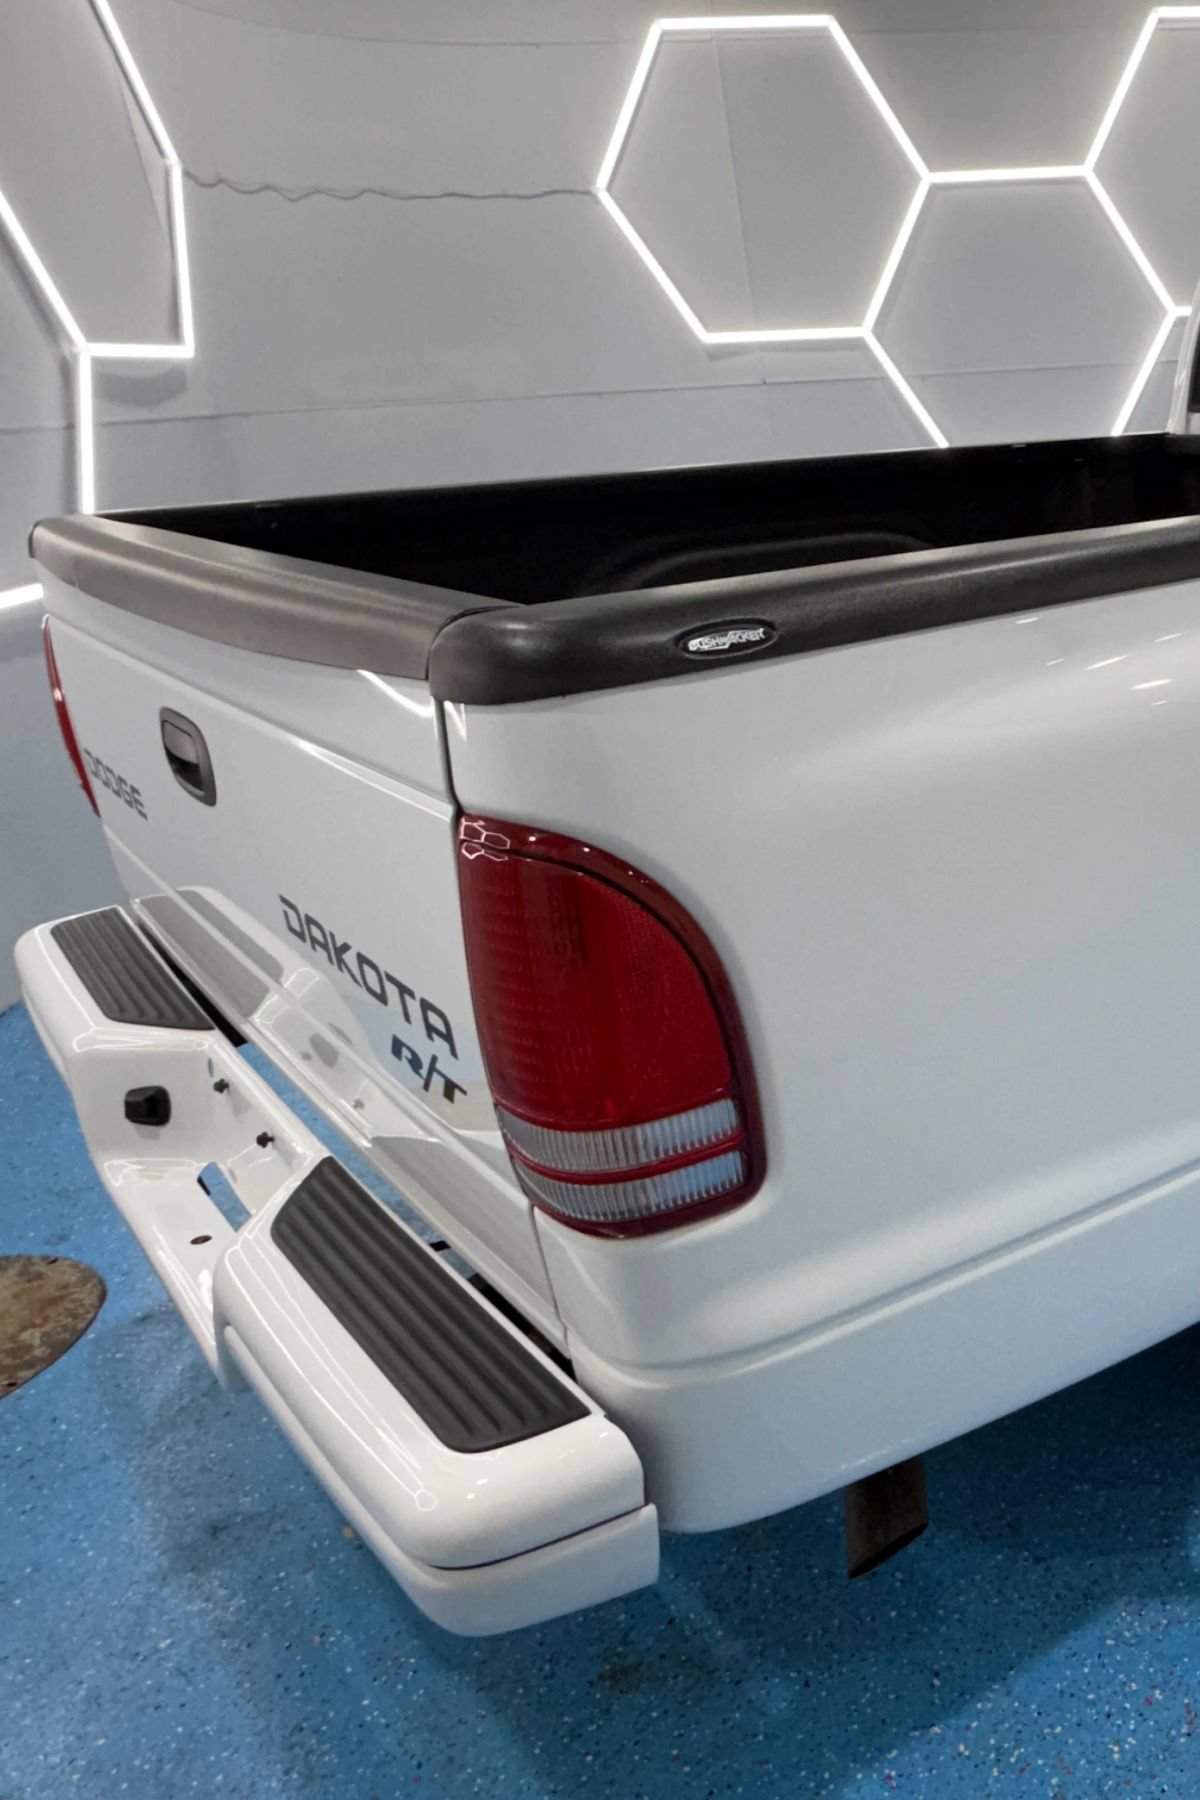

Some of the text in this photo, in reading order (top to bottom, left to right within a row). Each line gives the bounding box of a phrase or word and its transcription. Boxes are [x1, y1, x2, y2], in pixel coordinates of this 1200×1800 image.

[83, 747, 149, 821] DODGE
[279, 893, 459, 1060] DAKOTA
[391, 1033, 468, 1104] R/T
